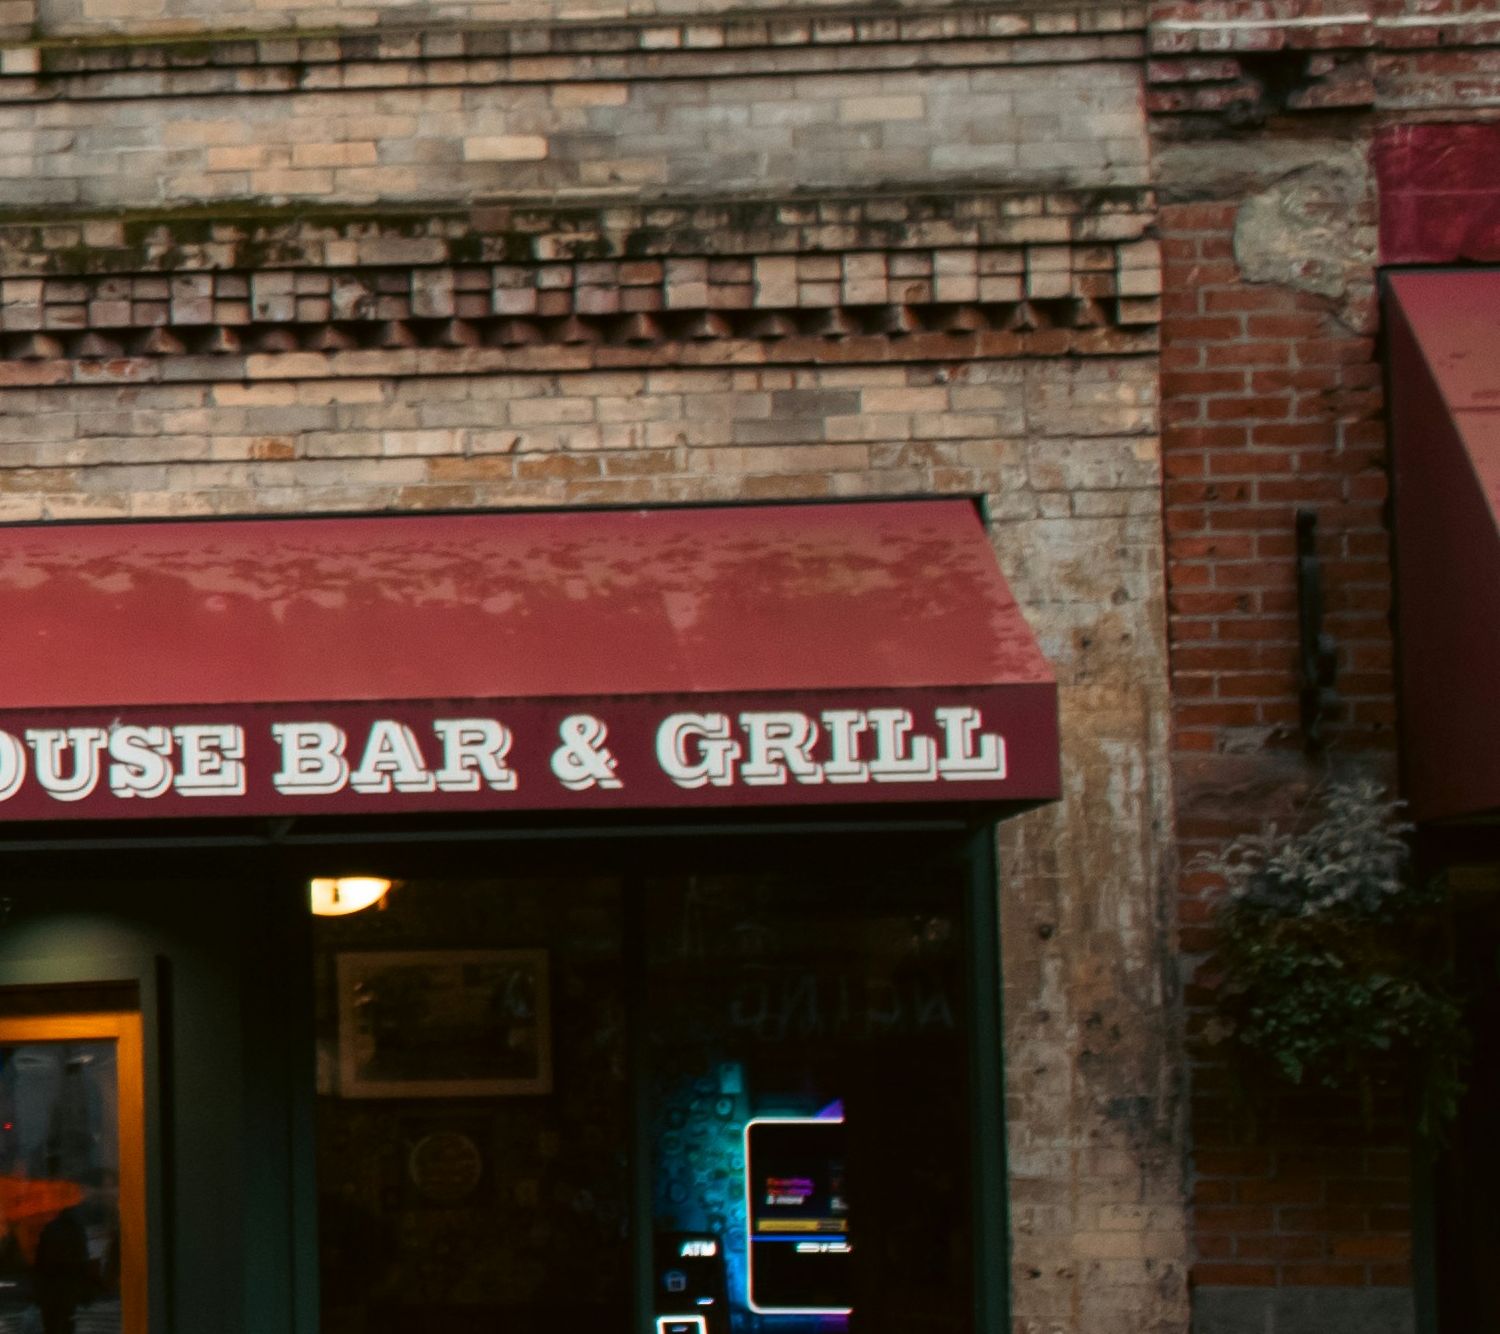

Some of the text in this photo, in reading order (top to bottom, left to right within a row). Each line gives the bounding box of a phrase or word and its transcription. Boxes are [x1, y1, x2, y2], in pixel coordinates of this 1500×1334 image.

[271, 716, 519, 796] BAR
[549, 712, 624, 791] &
[655, 706, 1008, 790] GRILL
[680, 1240, 718, 1258] ATM
